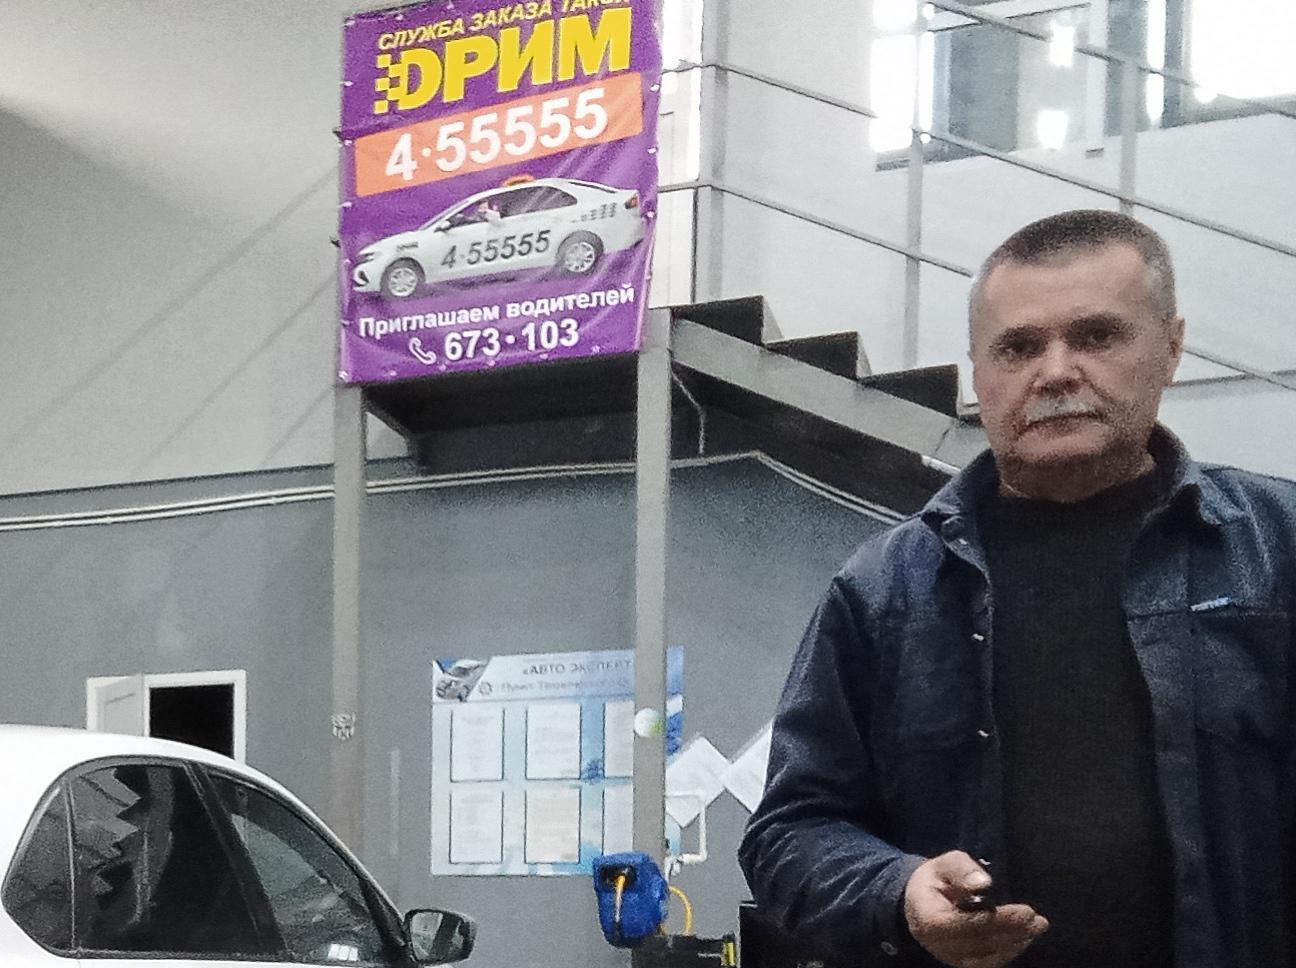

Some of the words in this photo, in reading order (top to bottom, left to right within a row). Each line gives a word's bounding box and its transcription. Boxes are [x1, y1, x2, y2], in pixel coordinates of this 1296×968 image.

[378, 19, 465, 50] СЛУЖБА
[468, 3, 552, 32] ЗАКАЗА
[559, 0, 631, 13] ТАК
[359, 304, 500, 339] Приглашаем
[506, 282, 636, 318] водителей
